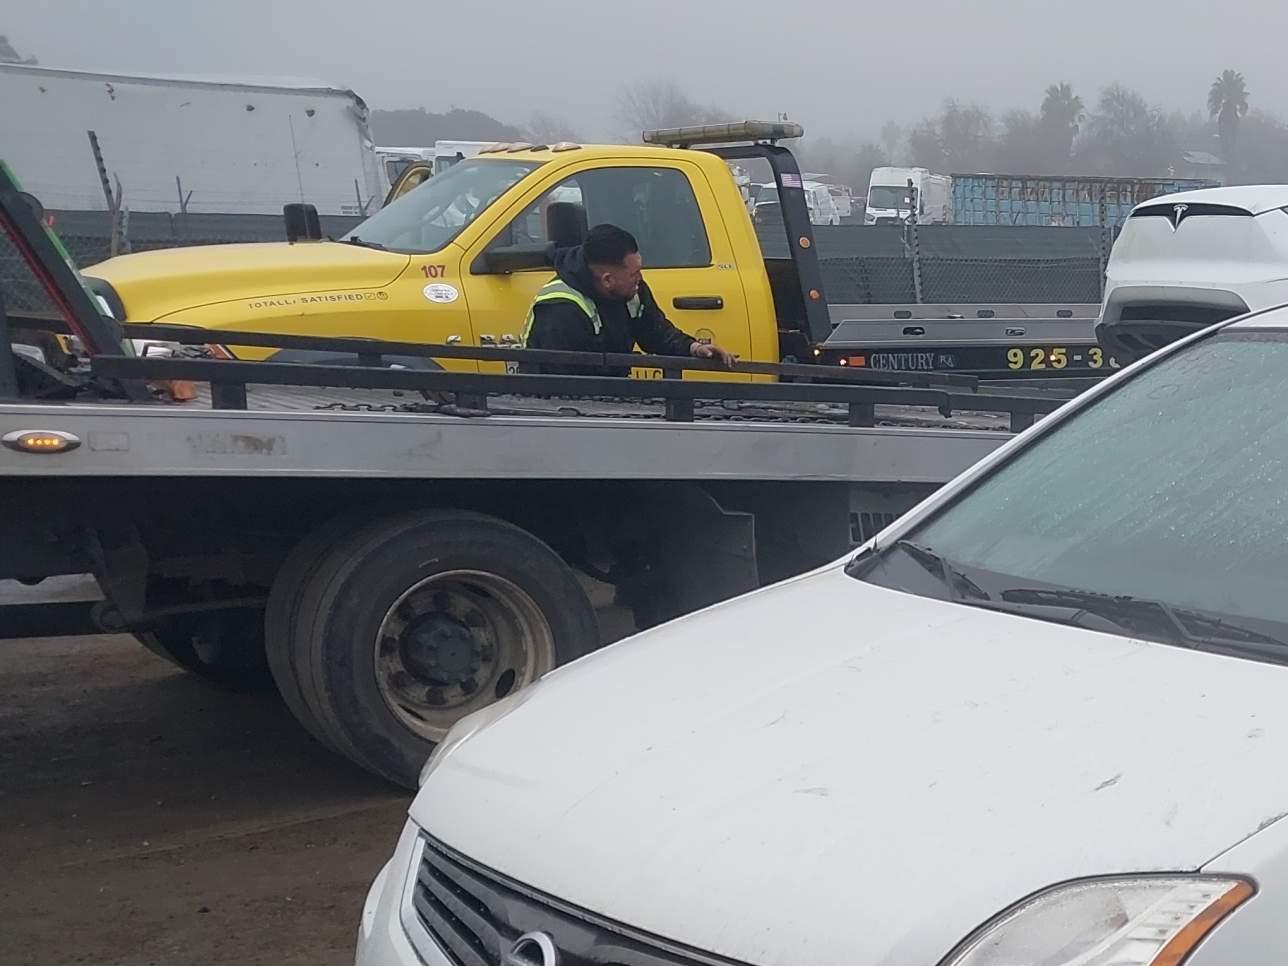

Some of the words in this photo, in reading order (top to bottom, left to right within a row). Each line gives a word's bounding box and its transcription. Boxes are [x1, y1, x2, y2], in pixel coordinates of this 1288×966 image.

[421, 264, 446, 278] 107
[301, 292, 363, 305] SATISFIED
[870, 352, 934, 370] CENTURY
